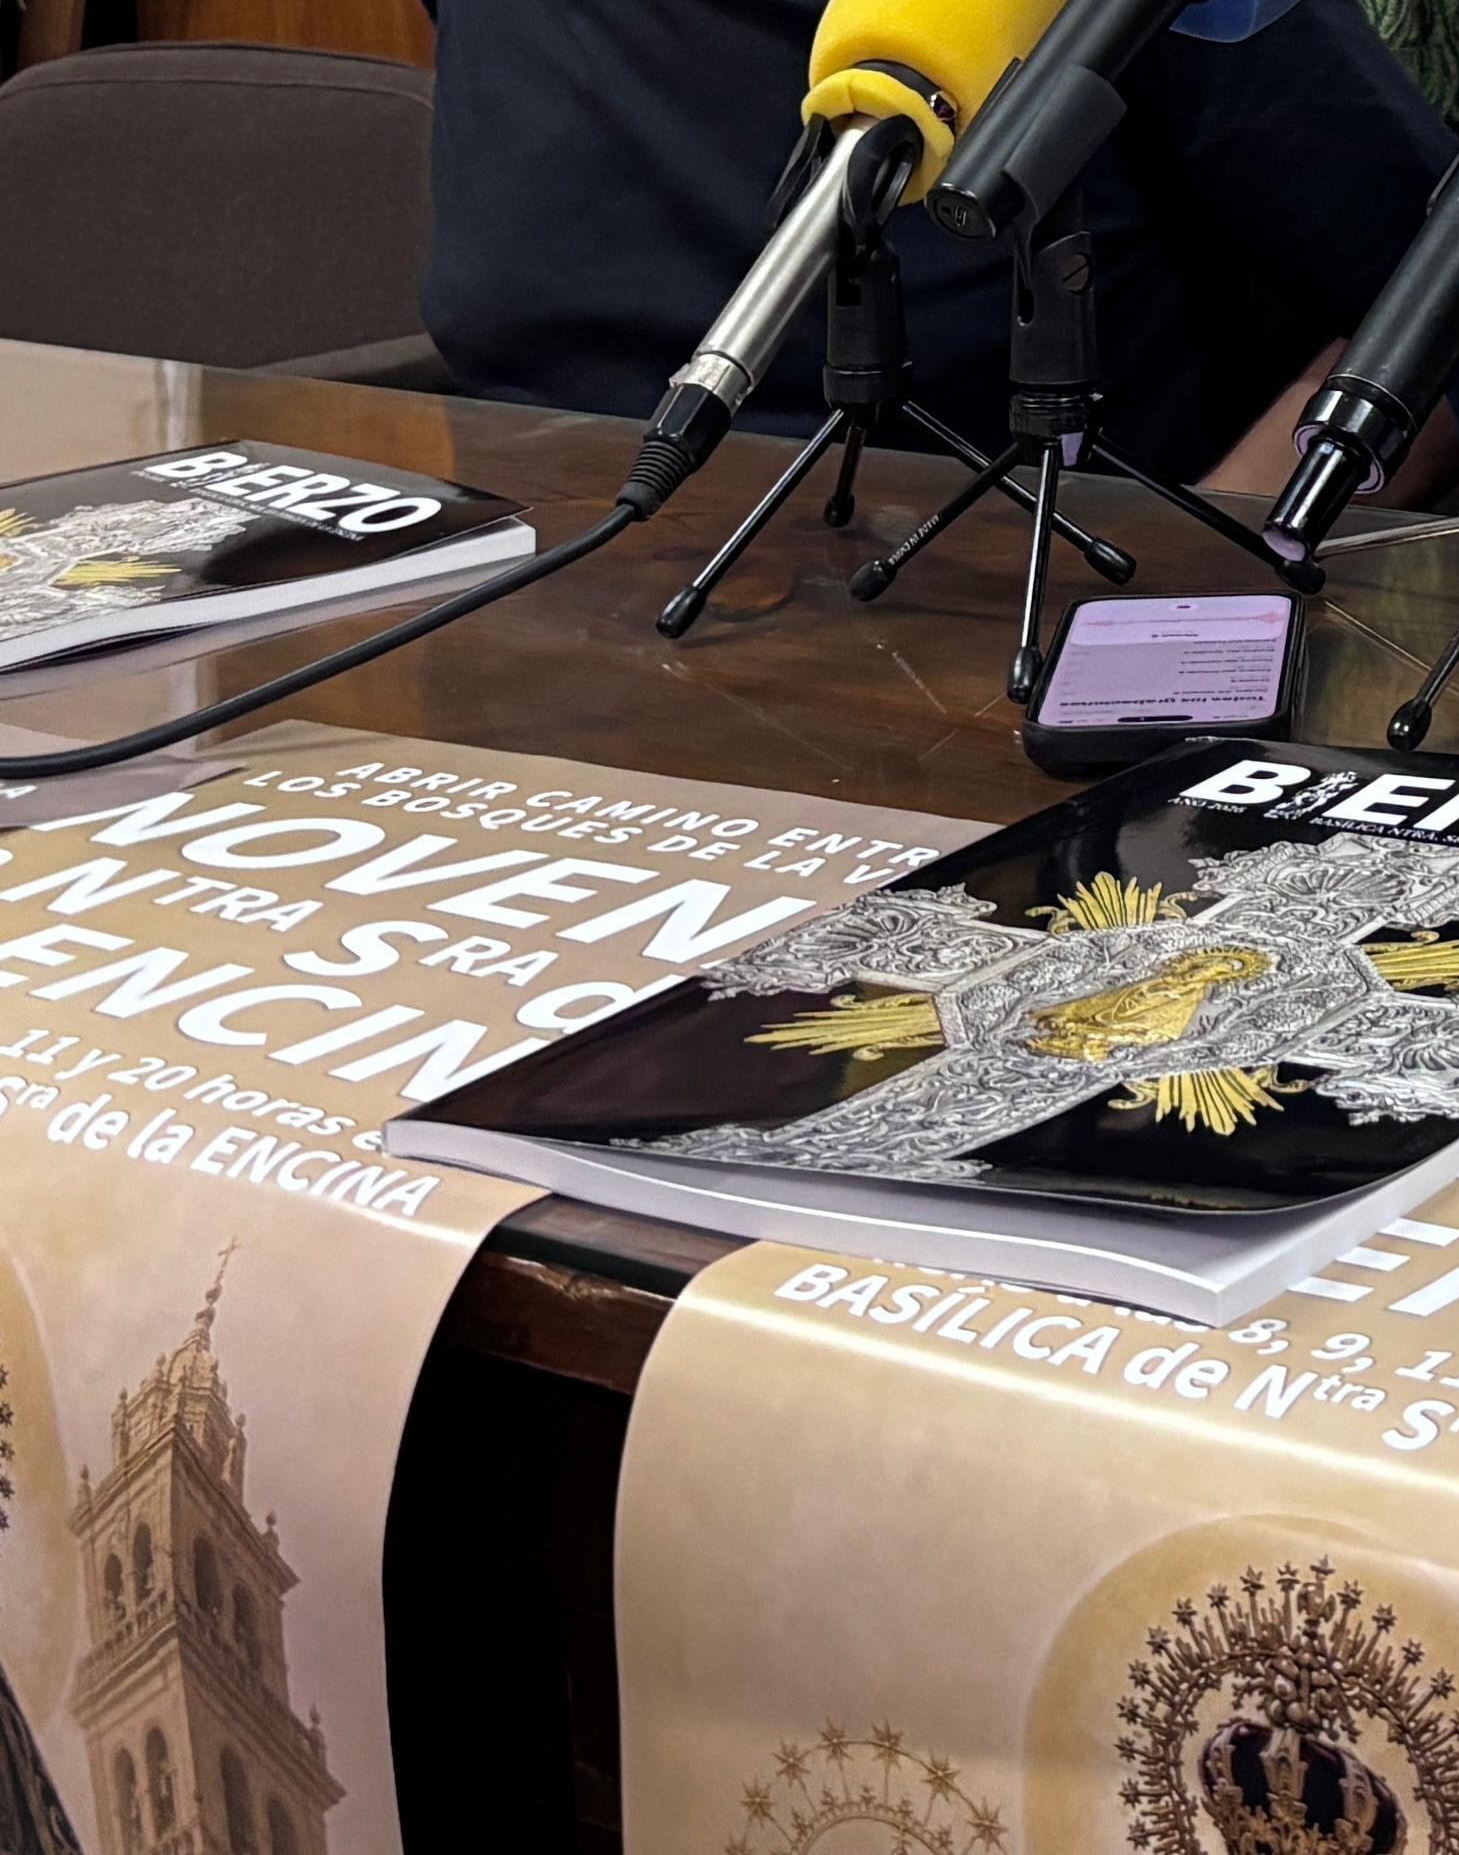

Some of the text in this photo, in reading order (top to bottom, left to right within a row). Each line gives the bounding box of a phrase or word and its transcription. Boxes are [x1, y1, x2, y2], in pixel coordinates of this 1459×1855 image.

[243, 771, 362, 797] LOS
[362, 787, 643, 846] BOSQUES
[646, 833, 742, 862] DE
[743, 850, 827, 884] LA
[337, 762, 943, 867] ABRIR CAMINO ENTR
[30, 792, 818, 968] NOVEN
[283, 919, 559, 986] SRA
[0, 923, 551, 1103] ENCIN
[54, 1048, 122, 1080] y
[107, 1057, 198, 1091] 20
[183, 1074, 357, 1135] horas
[47, 1093, 129, 1150] de
[127, 1108, 194, 1164] la
[190, 1126, 441, 1216] ENCINA
[773, 1263, 1122, 1376] BASÍLICA
[1123, 1341, 1230, 1400] de
[1233, 1364, 1387, 1420] Ntra
[1228, 1318, 1290, 1356] 8,
[1311, 1332, 1374, 1373] 9,
